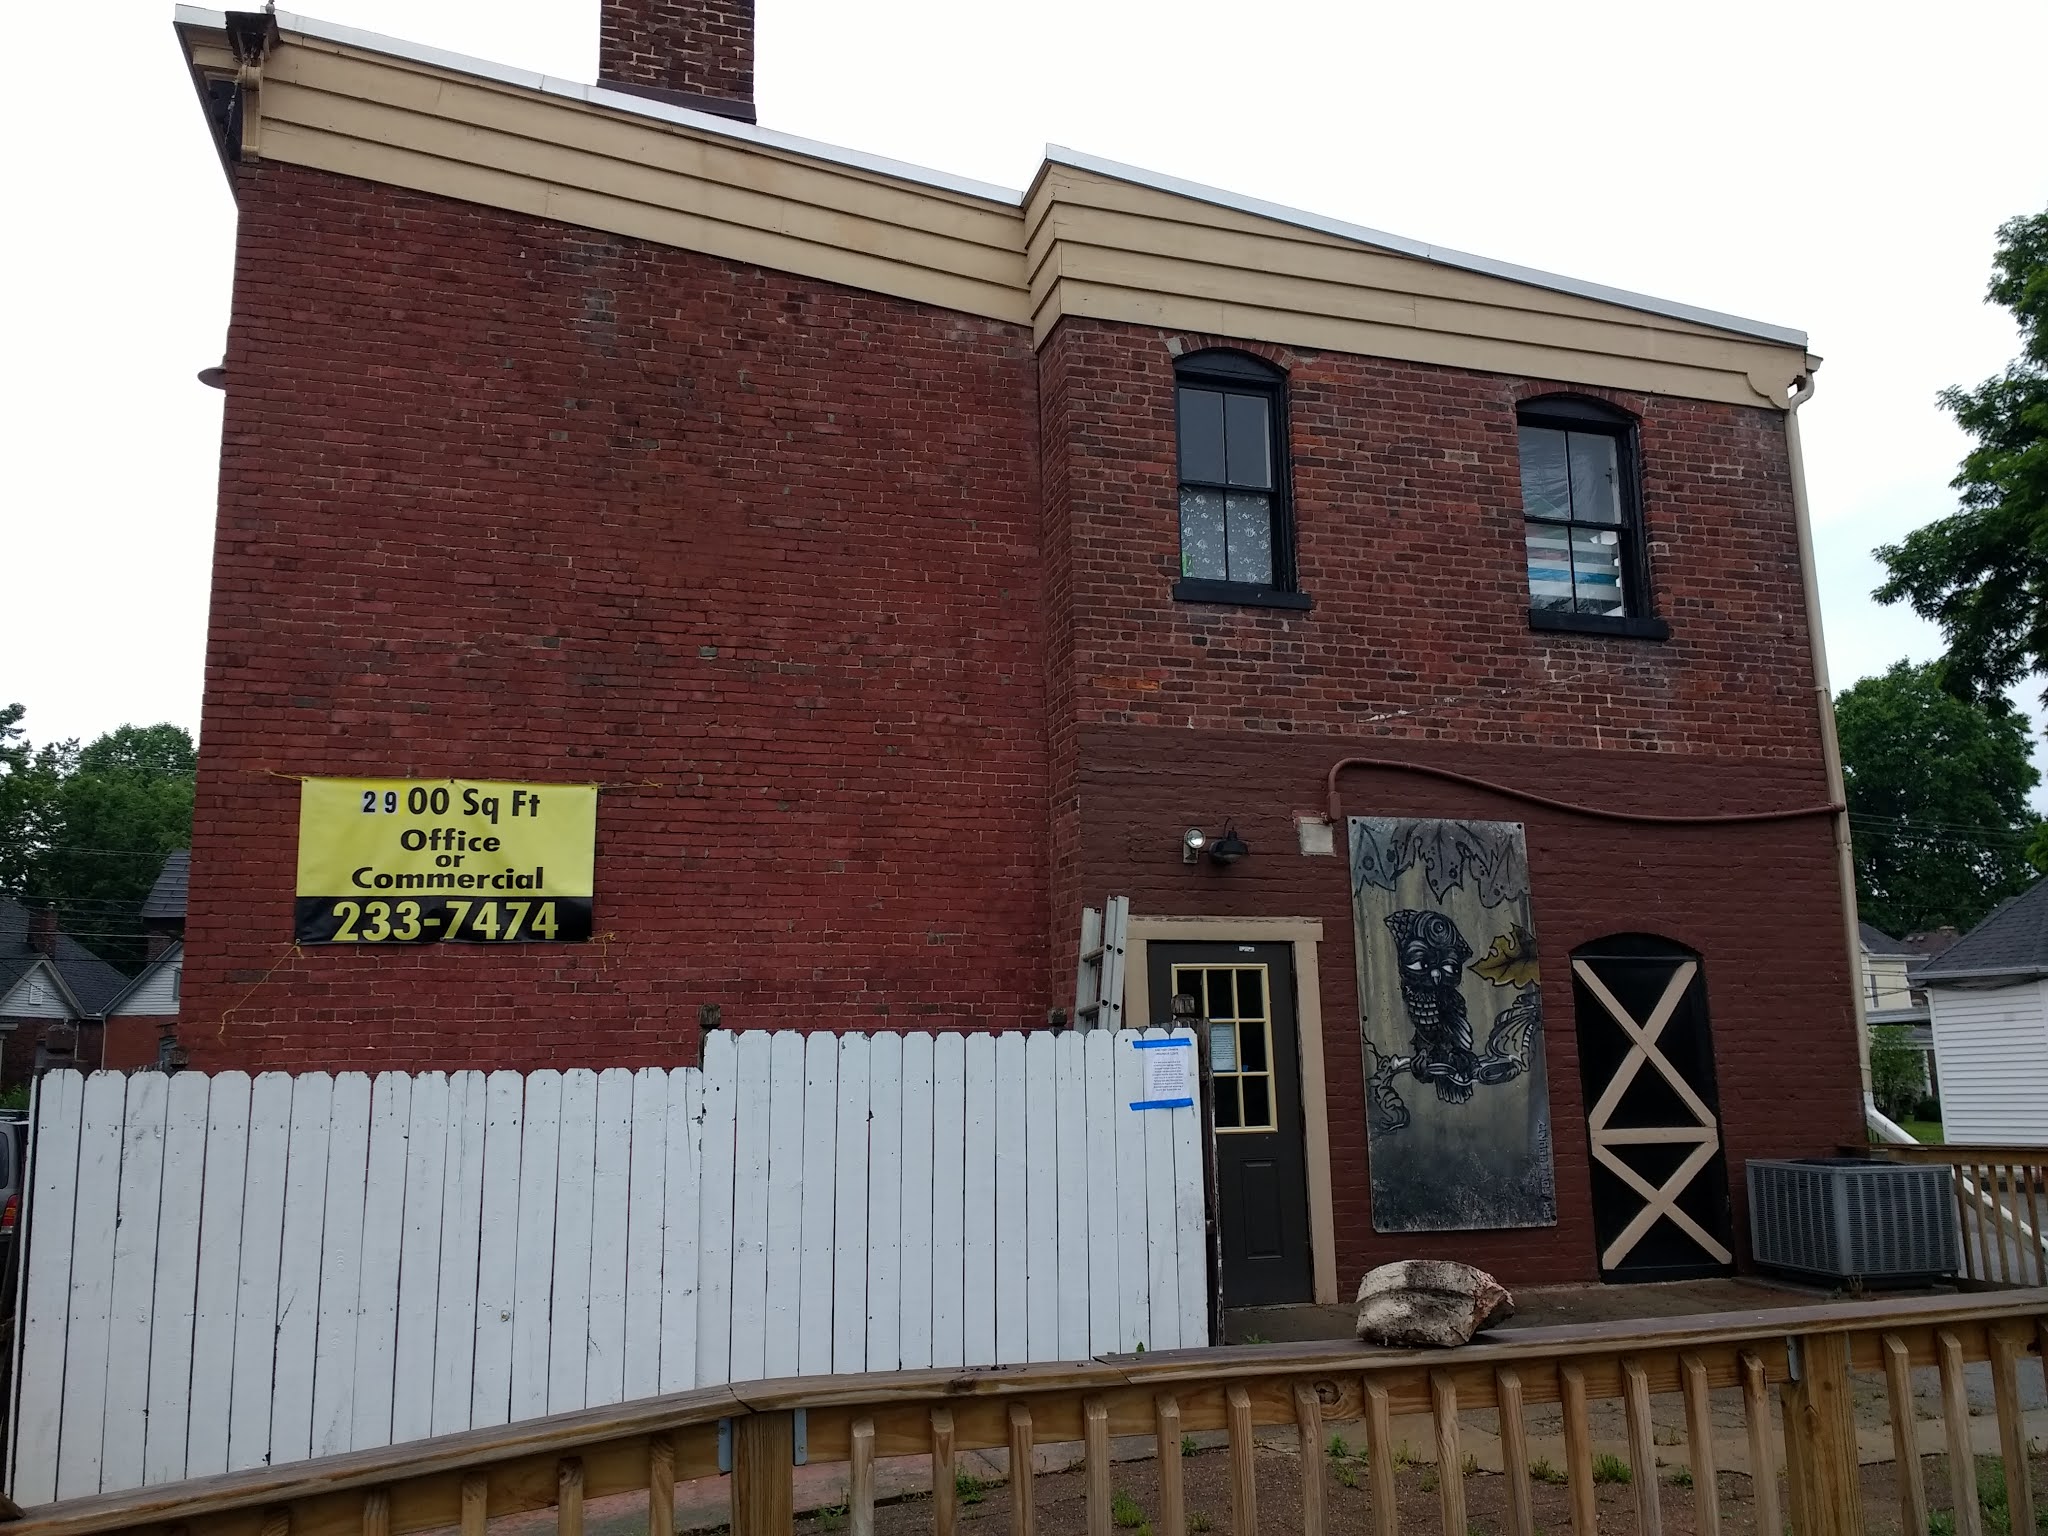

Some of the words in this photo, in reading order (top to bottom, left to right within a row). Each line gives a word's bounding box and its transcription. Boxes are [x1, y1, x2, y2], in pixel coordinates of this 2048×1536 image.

[463, 788, 499, 825] Sq
[511, 790, 541, 817] Ft
[400, 827, 501, 852] Office
[435, 854, 465, 868] or
[351, 866, 544, 890] Commercial
[331, 900, 559, 942] 233-7474
